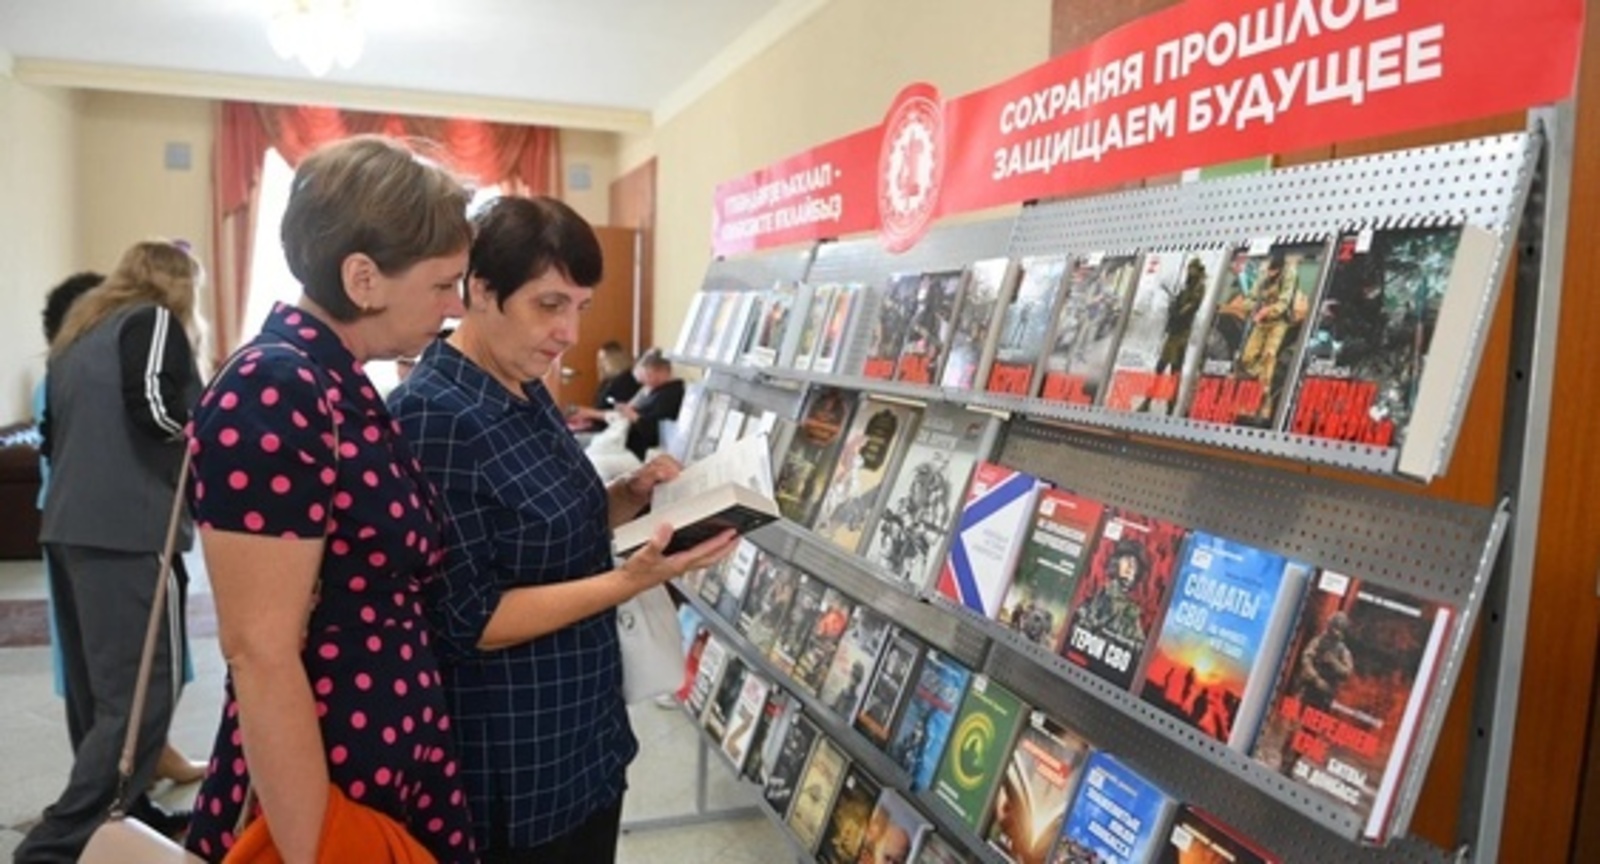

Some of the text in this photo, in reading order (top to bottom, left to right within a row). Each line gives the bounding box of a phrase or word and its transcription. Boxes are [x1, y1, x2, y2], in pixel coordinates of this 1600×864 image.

[992, 24, 1445, 179] ЗАЩИЩАЕМ БУДУЩЕЕ
[999, 52, 1144, 135] СОХРАНЯЯ
[1174, 603, 1208, 633] СВО
[1184, 573, 1262, 620] СОЛДАТЫ
[1105, 640, 1132, 672] СВО
